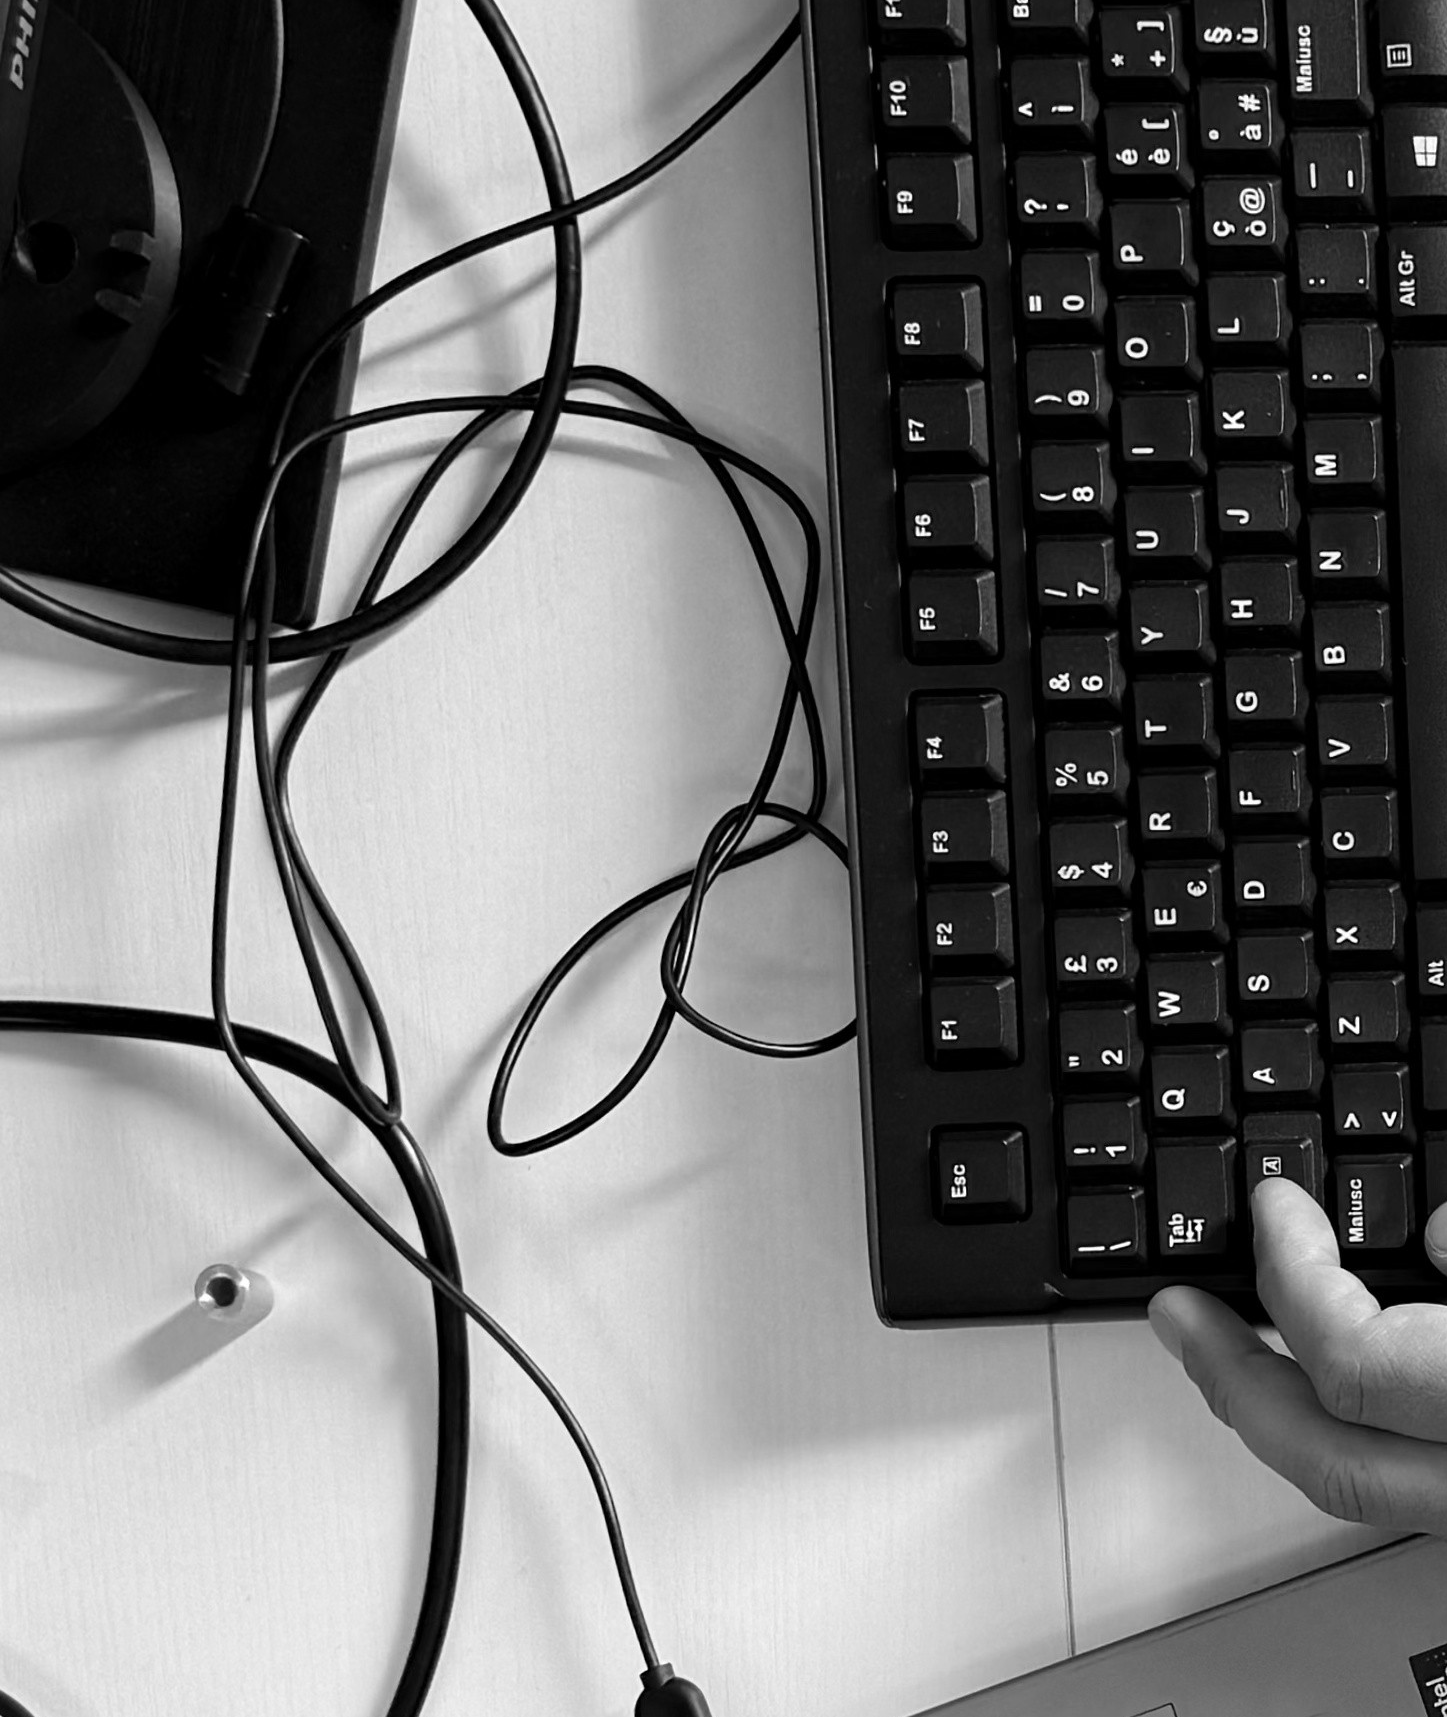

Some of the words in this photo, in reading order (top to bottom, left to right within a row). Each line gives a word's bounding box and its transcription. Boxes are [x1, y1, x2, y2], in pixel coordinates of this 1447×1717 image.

[1295, 24, 1313, 92] Maiusc
[889, 80, 907, 116] F10
[896, 190, 914, 214] F9
[1120, 244, 1144, 263] P
[1397, 250, 1415, 276] Gr
[1399, 278, 1416, 307] Alt
[903, 322, 921, 345] F8
[1217, 317, 1240, 334] L
[1124, 337, 1149, 359] O
[907, 418, 926, 442] F7
[1314, 454, 1337, 476] M
[914, 513, 932, 537] F6
[1319, 551, 1342, 570] N
[918, 607, 936, 631] F5
[1323, 645, 1346, 665] B
[1144, 719, 1167, 738] T
[926, 736, 943, 759] F4
[1327, 738, 1351, 758] V
[1238, 790, 1262, 806] F
[1149, 812, 1172, 831] R
[932, 830, 949, 853] F3
[1332, 831, 1355, 851] C
[1243, 880, 1265, 900] D
[1153, 907, 1177, 926] E
[935, 922, 953, 946] F2
[1335, 926, 1359, 944] X
[1247, 974, 1270, 992] S
[1427, 959, 1445, 987] Alt
[1157, 991, 1181, 1018] W
[941, 1020, 958, 1040] F1
[1338, 1016, 1360, 1035] Z
[1252, 1067, 1275, 1084] A
[1161, 1088, 1186, 1111] Q
[950, 1164, 967, 1198] Esc
[1348, 1178, 1364, 1243] Maiusc
[1168, 1213, 1186, 1248] Tab
